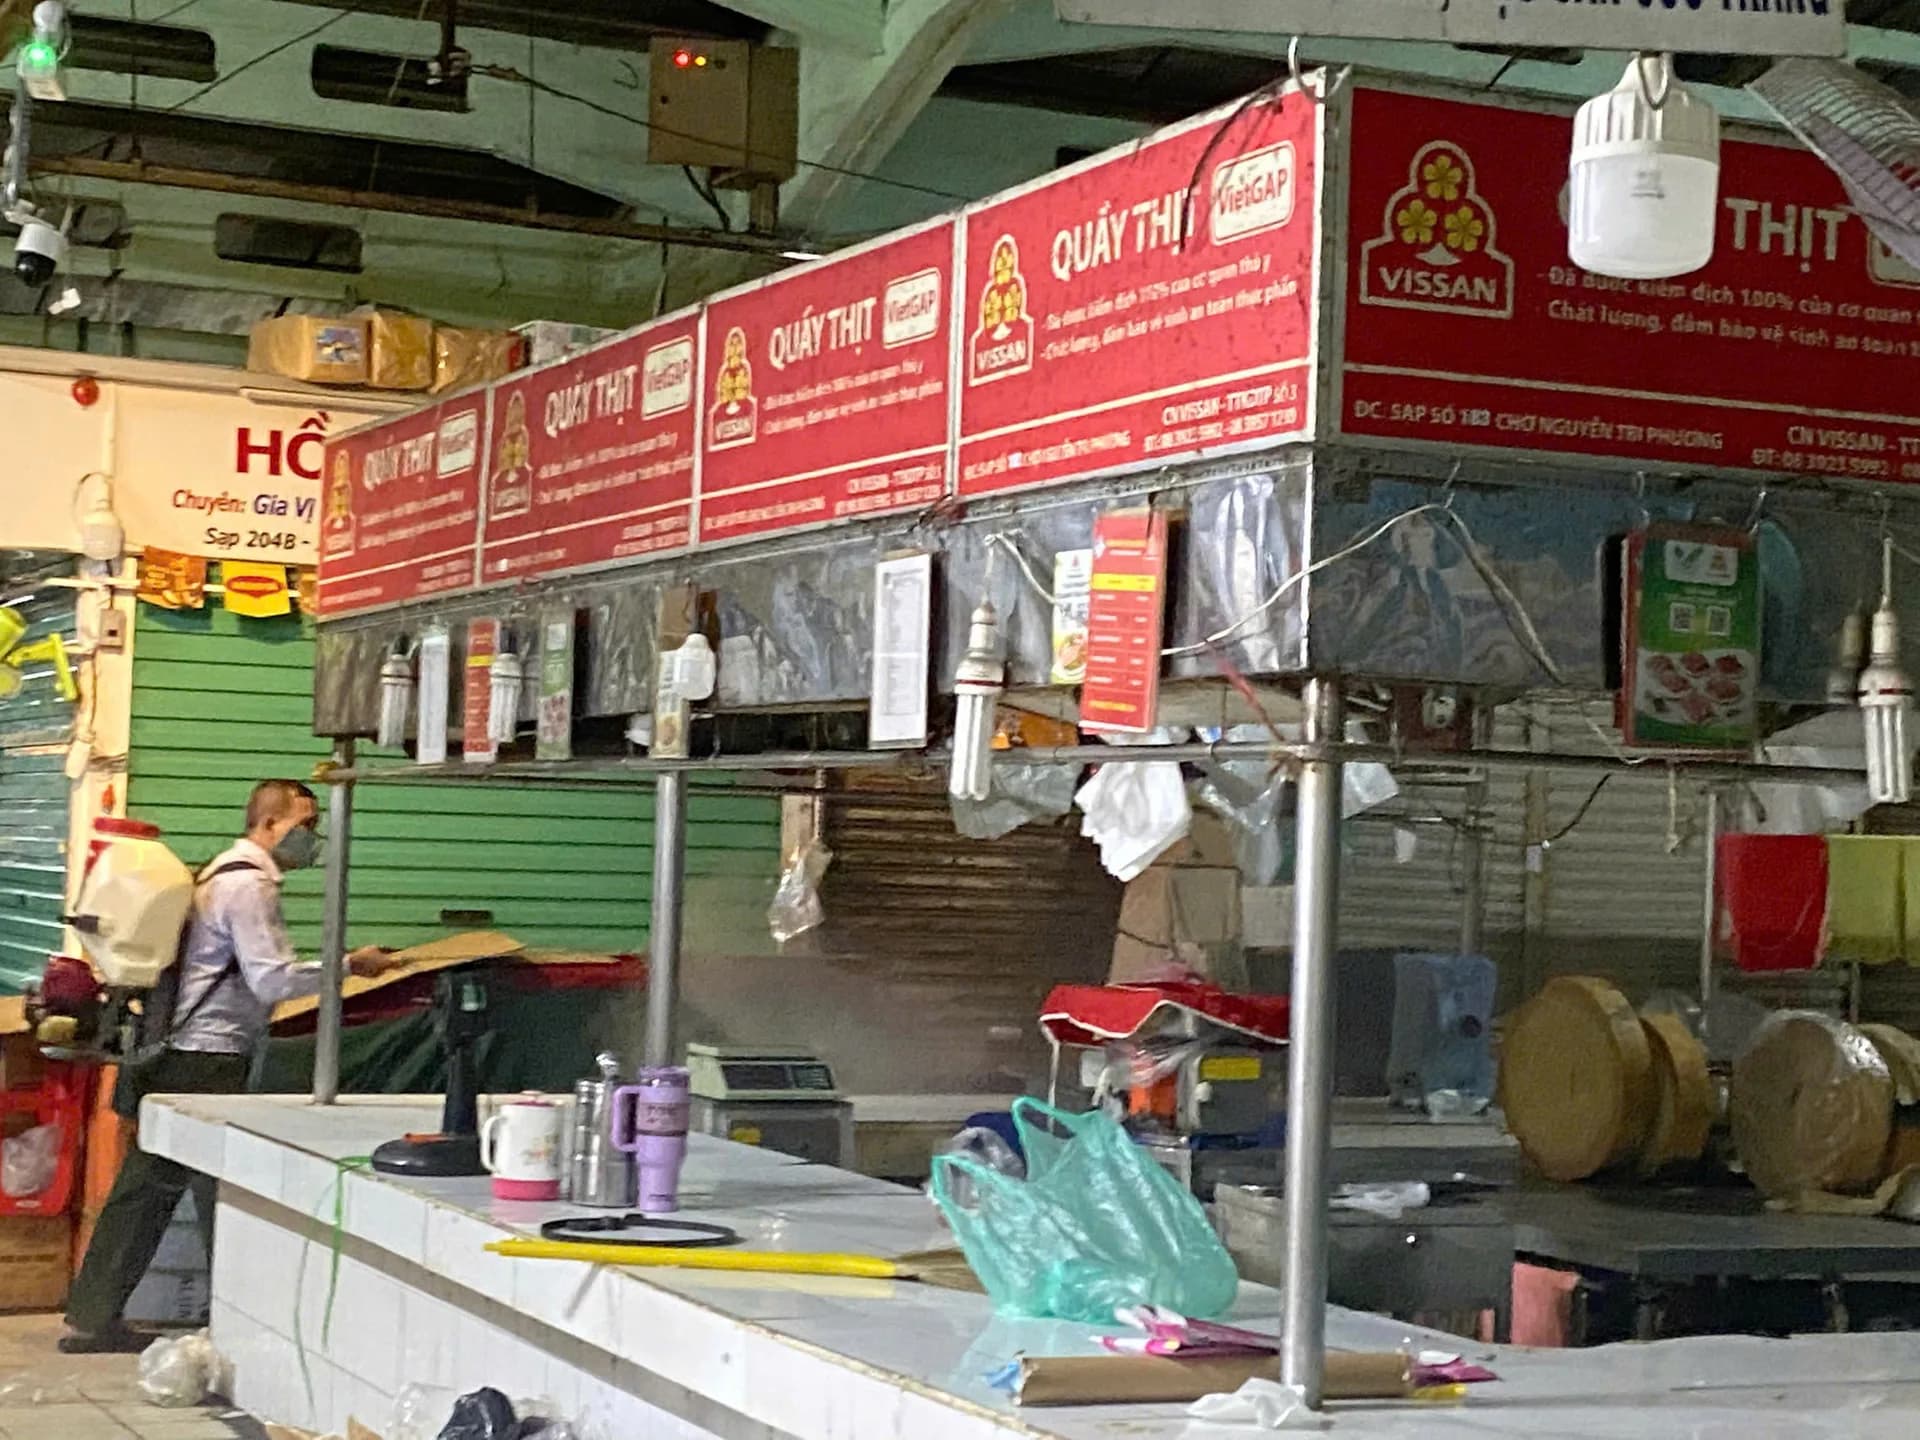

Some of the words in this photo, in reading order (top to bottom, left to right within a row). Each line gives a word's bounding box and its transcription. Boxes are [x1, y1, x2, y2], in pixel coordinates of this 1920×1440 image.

[1725, 198, 1848, 272] THỊT
[1379, 266, 1497, 304] VISSAN
[1692, 281, 1734, 305] dịch
[1799, 294, 1833, 316] của
[827, 296, 877, 356] THỊT
[253, 493, 289, 516] Gia
[295, 497, 316, 524] Vị
[246, 530, 297, 550] 204B
